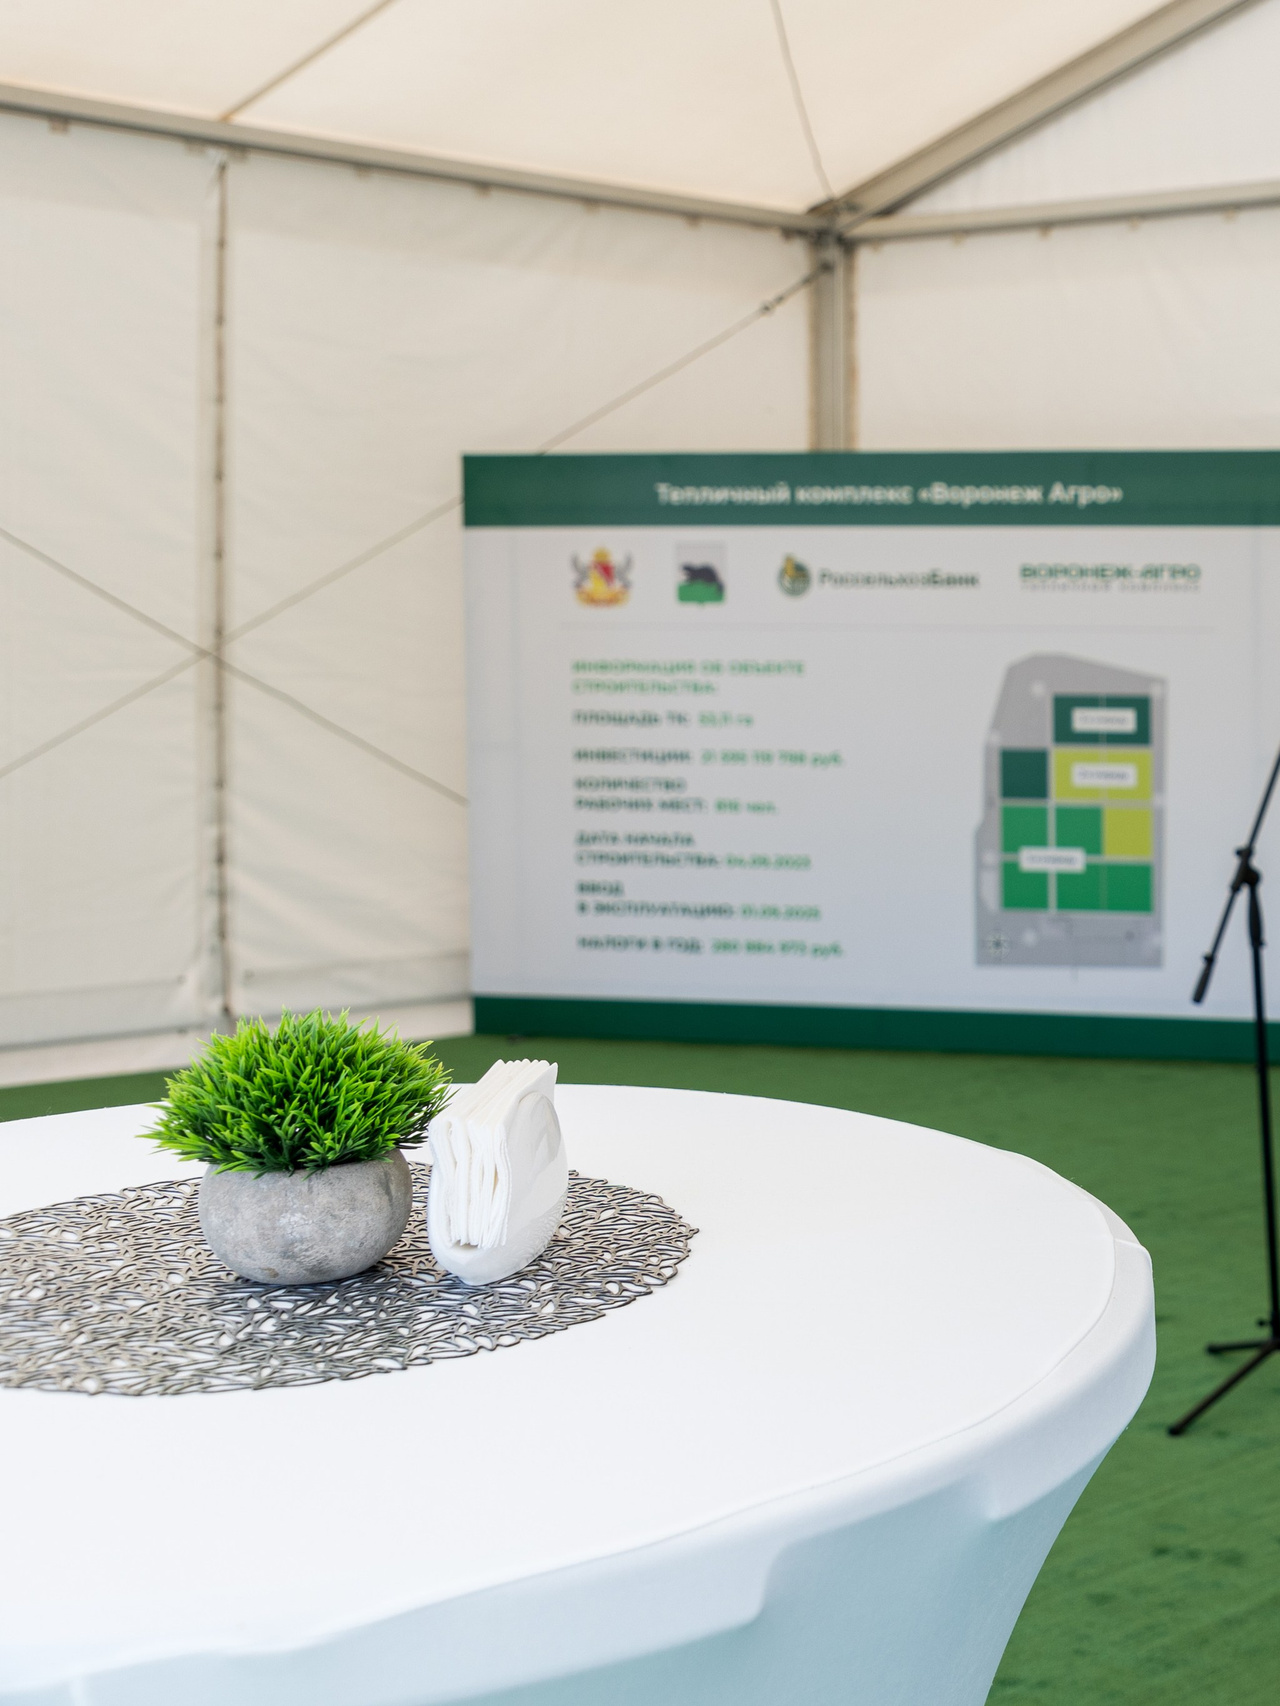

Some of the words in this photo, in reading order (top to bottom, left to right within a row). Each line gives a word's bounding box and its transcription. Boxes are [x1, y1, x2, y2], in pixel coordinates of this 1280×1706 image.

[654, 482, 790, 505] Тепличный
[795, 486, 914, 505] комплекс
[917, 483, 1044, 509] «Воронеж
[1047, 482, 1124, 509] Агро»
[816, 569, 980, 591] РоссельхозБанк
[1018, 563, 1202, 582] ВОРОНЕЖ-АГРО
